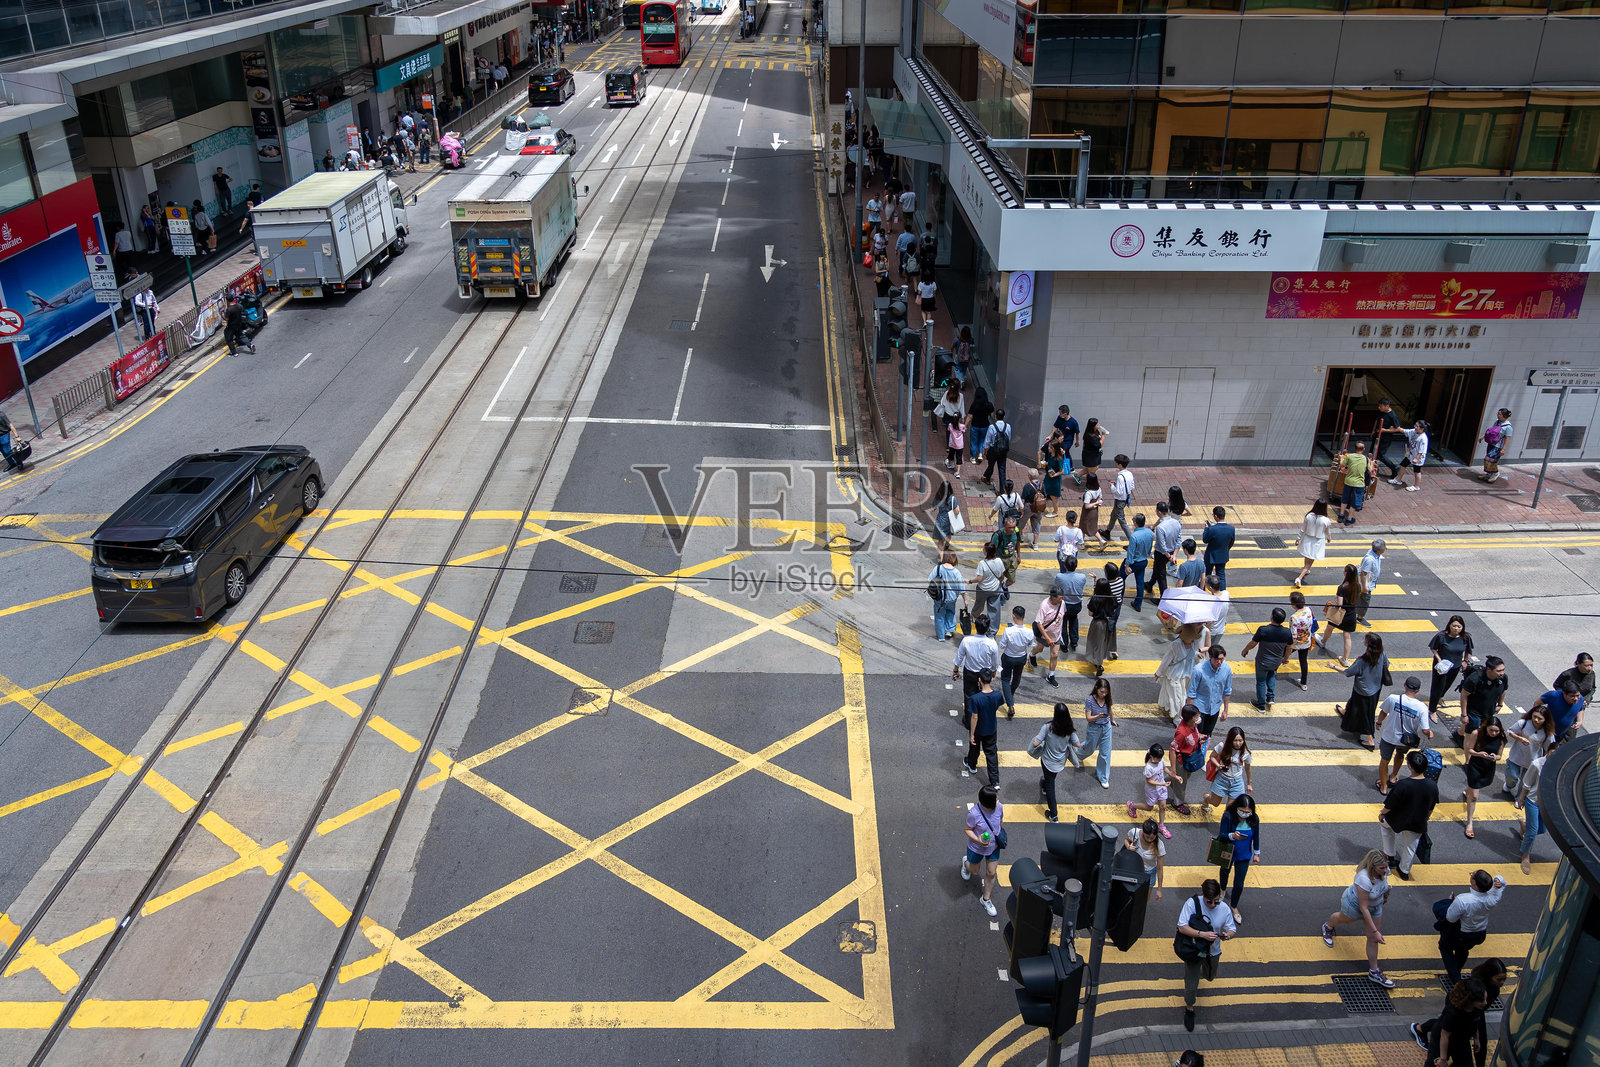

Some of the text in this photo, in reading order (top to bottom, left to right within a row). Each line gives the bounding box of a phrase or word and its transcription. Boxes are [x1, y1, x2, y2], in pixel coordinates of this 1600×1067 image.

[1153, 226, 1272, 248] 集友銀行
[1152, 250, 1269, 258] Chiyu Banking Corporation Ltd.
[1294, 278, 1351, 289] 集友銀行
[1356, 300, 1436, 310] 熱烈慶祝香港回歸
[1358, 324, 1481, 337] 集友銀行大廈
